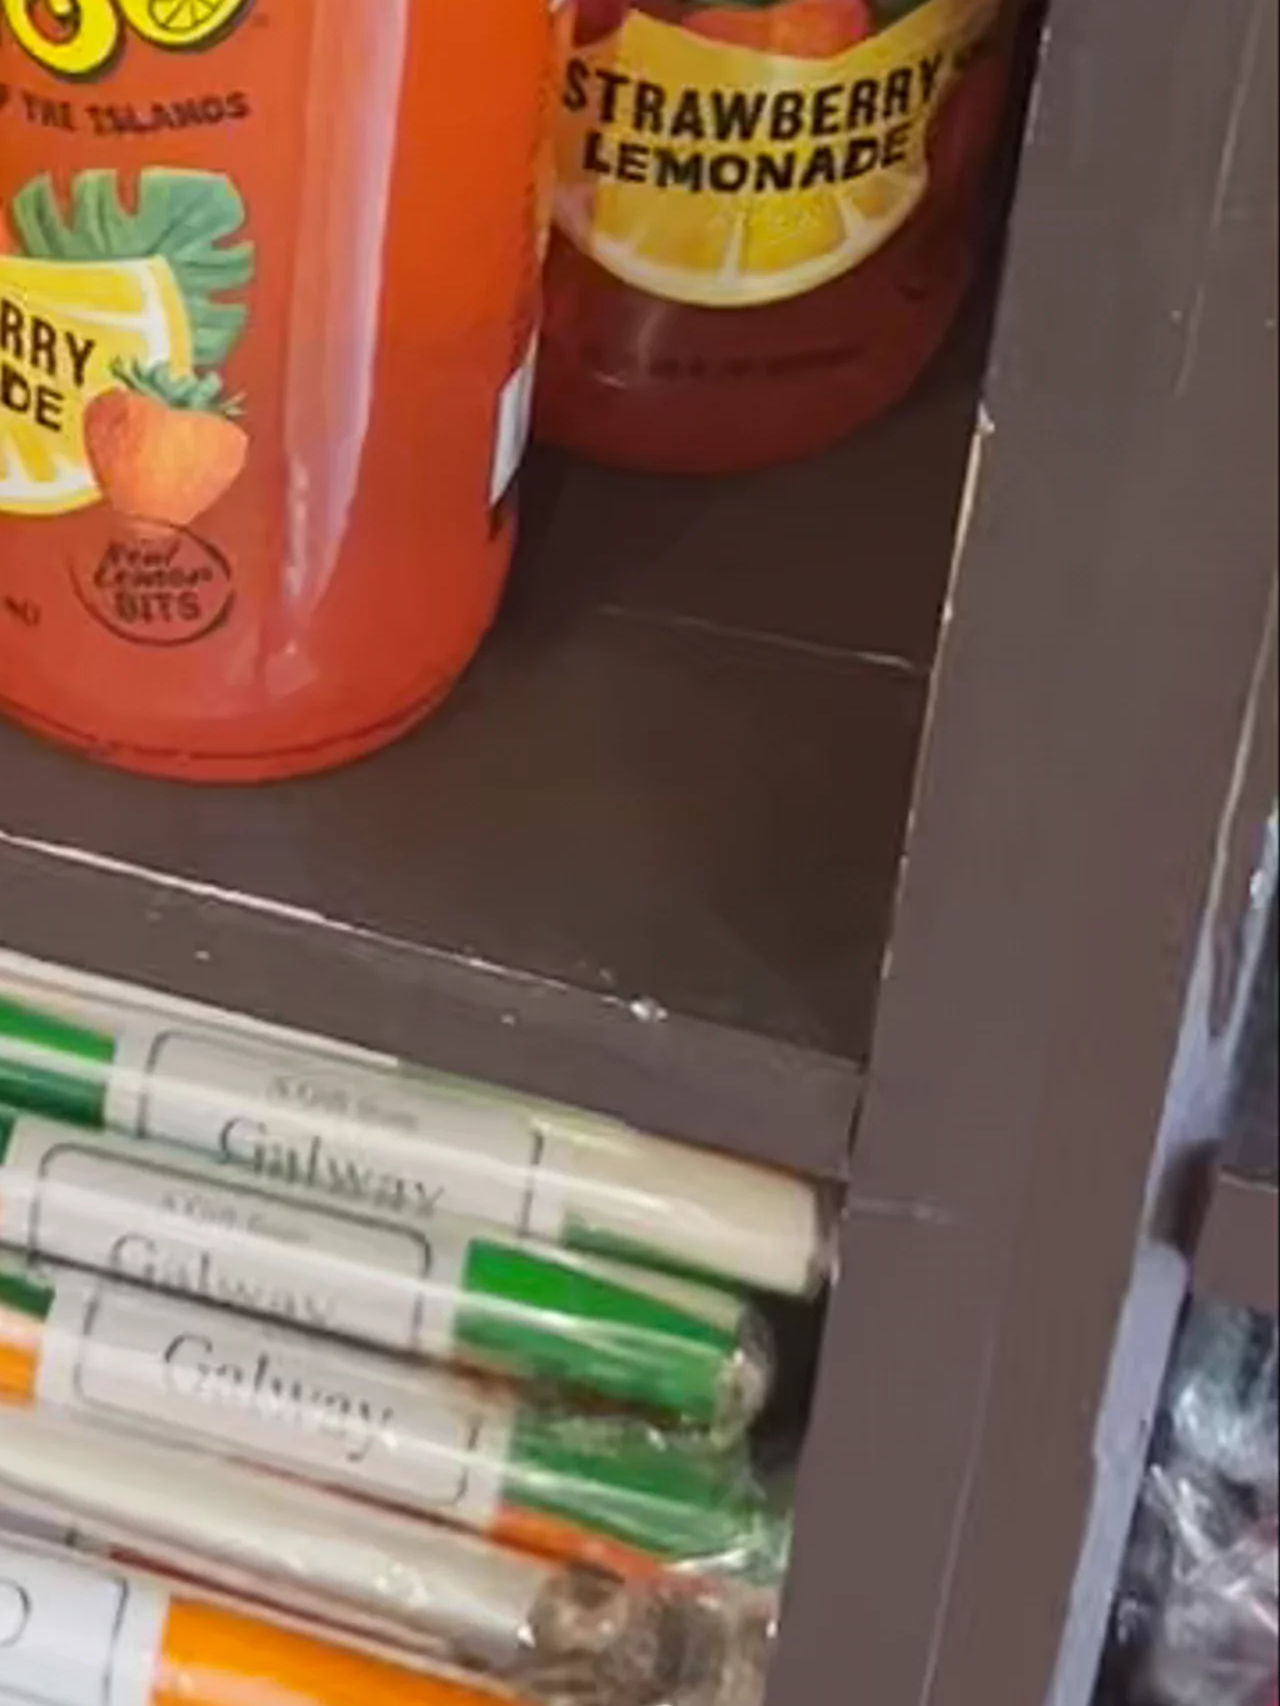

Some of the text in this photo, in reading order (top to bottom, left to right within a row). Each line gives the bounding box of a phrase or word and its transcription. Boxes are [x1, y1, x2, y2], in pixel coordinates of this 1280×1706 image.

[562, 50, 943, 143] STRAWBERRY
[583, 122, 914, 195] LEMONADE
[162, 1331, 398, 1462] Galway
